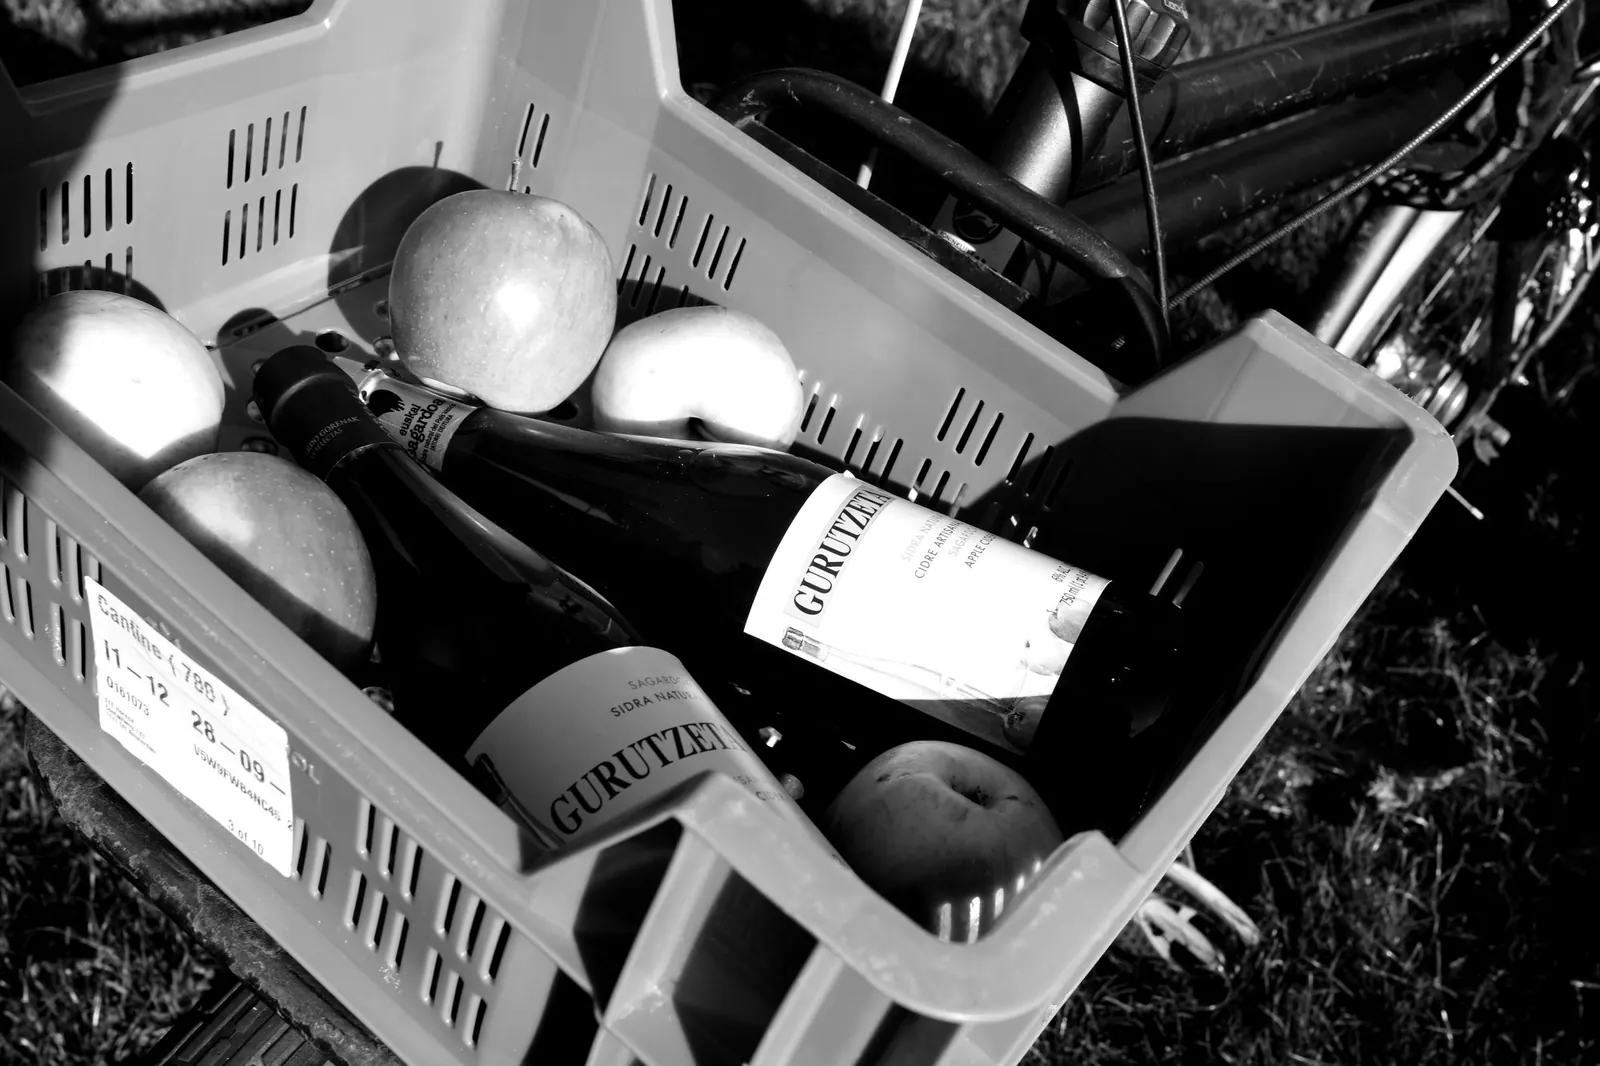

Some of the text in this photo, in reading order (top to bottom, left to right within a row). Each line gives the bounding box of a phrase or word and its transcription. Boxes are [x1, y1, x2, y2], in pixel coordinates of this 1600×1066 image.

[399, 403, 421, 437] euskal
[793, 489, 891, 615] GURUTZETA
[914, 548, 938, 579] CIDRE
[965, 544, 986, 569] APPLE
[98, 594, 162, 660] Cantine
[610, 696, 653, 717] SIDRA
[191, 710, 216, 744] 28
[240, 749, 265, 783] 09
[550, 722, 748, 835] GURUTZETA
[238, 829, 248, 842] of
[252, 839, 264, 856] 10
